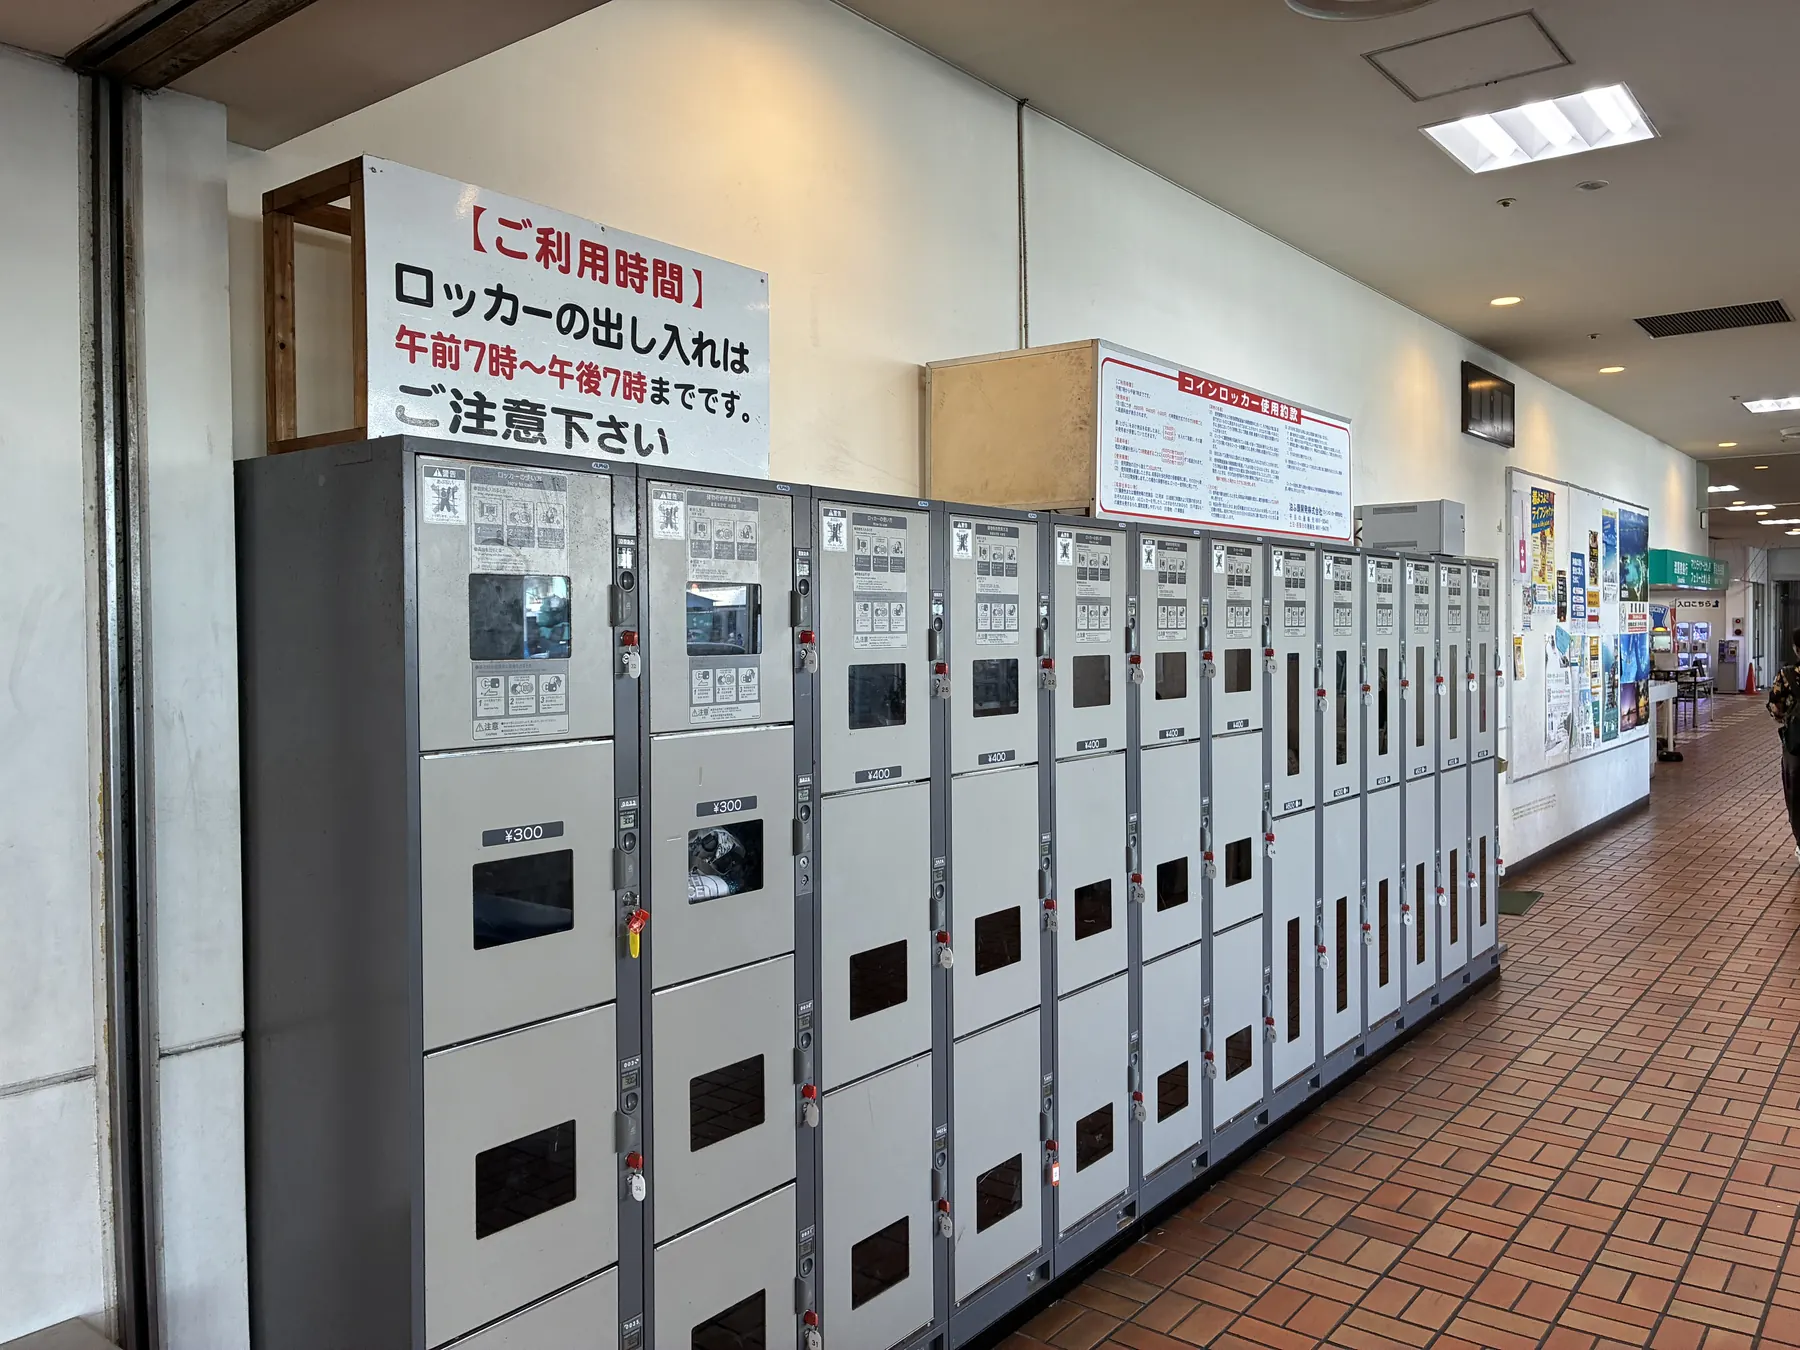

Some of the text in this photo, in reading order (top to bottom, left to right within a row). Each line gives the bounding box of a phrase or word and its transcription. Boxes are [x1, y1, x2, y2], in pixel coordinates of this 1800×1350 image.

[473, 205, 703, 308] 【ご利用時間】
[395, 262, 750, 374] ロッカーの出し入れは
[1184, 376, 1299, 423] コインロッカー使用約款
[398, 382, 670, 457] ご注意下さい
[442, 469, 457, 478] 警告
[1677, 600, 1712, 608] 入口こちら
[484, 722, 499, 731] 注意
[1165, 729, 1179, 738] ¥400
[1084, 739, 1100, 750] ¥400
[987, 751, 1007, 764] ¥400
[867, 768, 891, 781] ¥400
[713, 799, 742, 814] ¥300
[504, 825, 544, 843] ¥300
